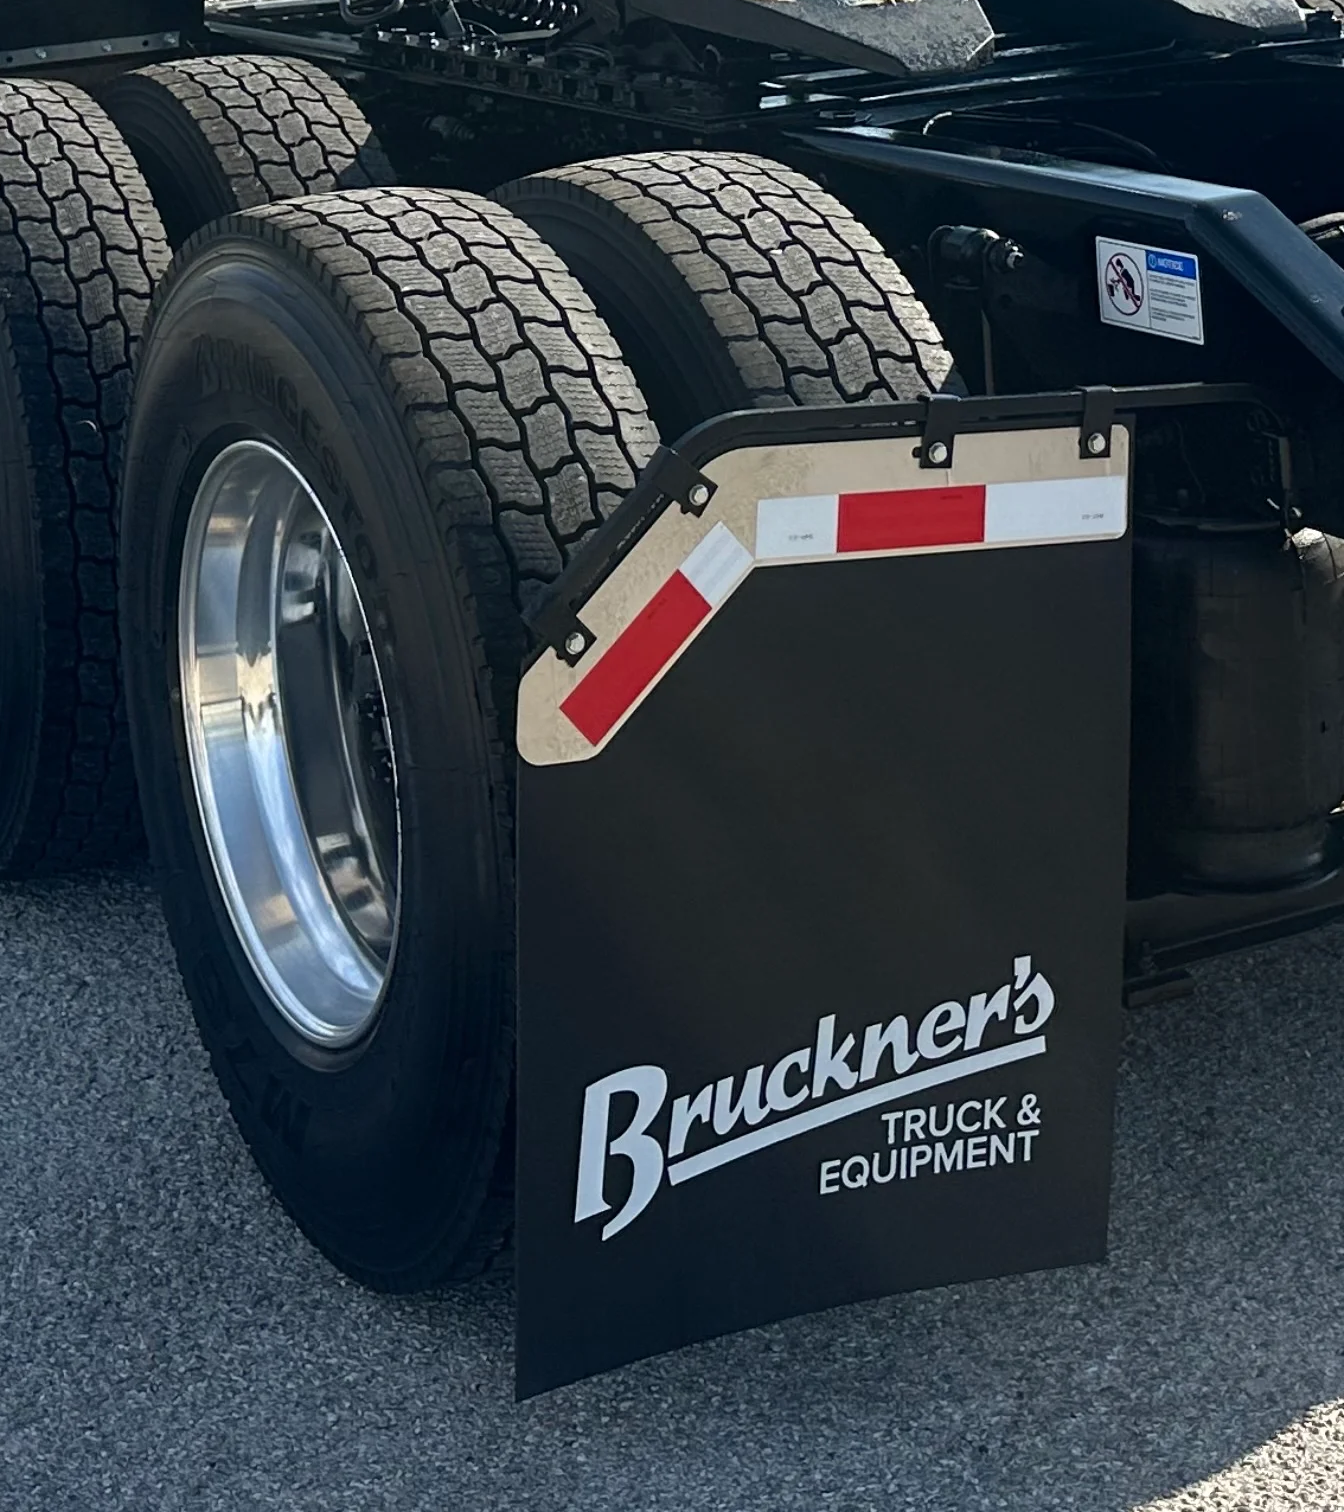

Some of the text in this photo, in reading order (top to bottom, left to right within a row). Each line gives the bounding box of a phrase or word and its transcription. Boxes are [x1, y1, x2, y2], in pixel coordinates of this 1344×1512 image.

[575, 955, 1056, 1242] Bruckner's
[881, 1093, 1042, 1145] TRUCK &
[819, 1129, 1040, 1195] EQUIPMENT
